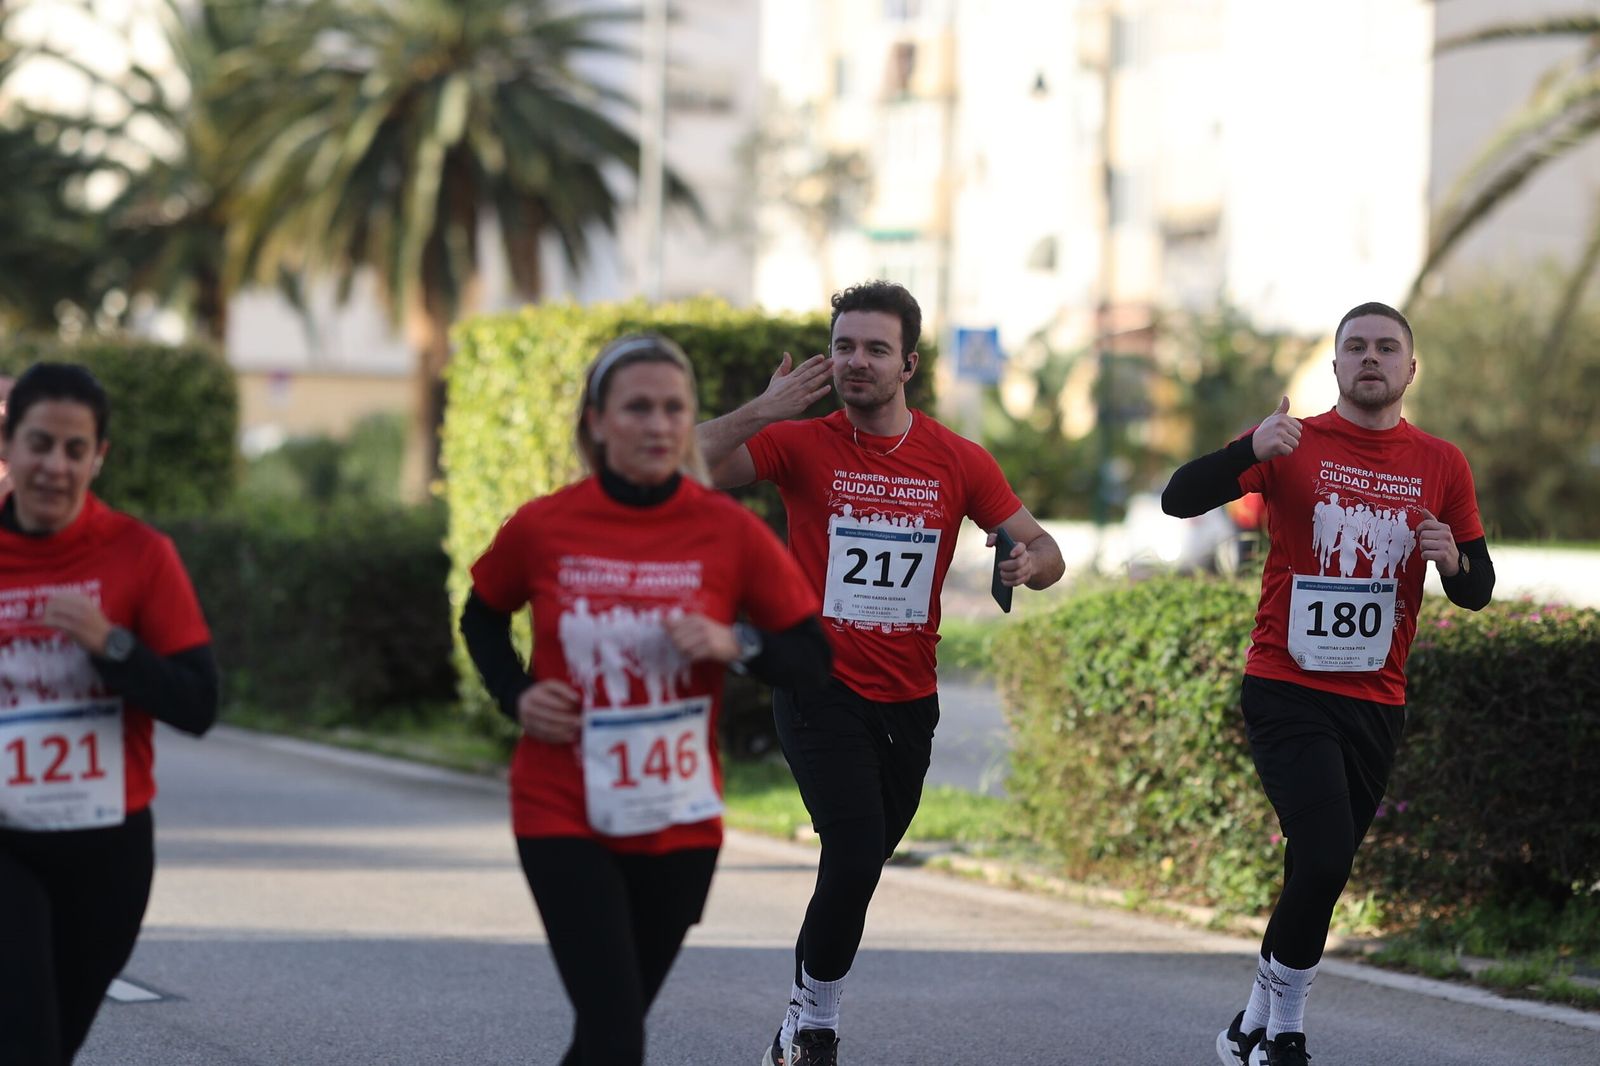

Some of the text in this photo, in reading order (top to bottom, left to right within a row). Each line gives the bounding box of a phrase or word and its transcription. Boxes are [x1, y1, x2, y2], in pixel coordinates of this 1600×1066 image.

[834, 469, 939, 488] VIII CARRERA URBANA DE
[1320, 460, 1422, 485] VIII CARRERA URBANA DE
[1320, 469, 1421, 497] CIUDAD JARDÍN
[1325, 481, 1342, 490] Colegio
[832, 479, 938, 501] CIUDAD JARDÍN
[843, 547, 923, 588] 217
[1306, 601, 1382, 638] 180
[5, 730, 108, 787] 121
[608, 731, 699, 789] 146
